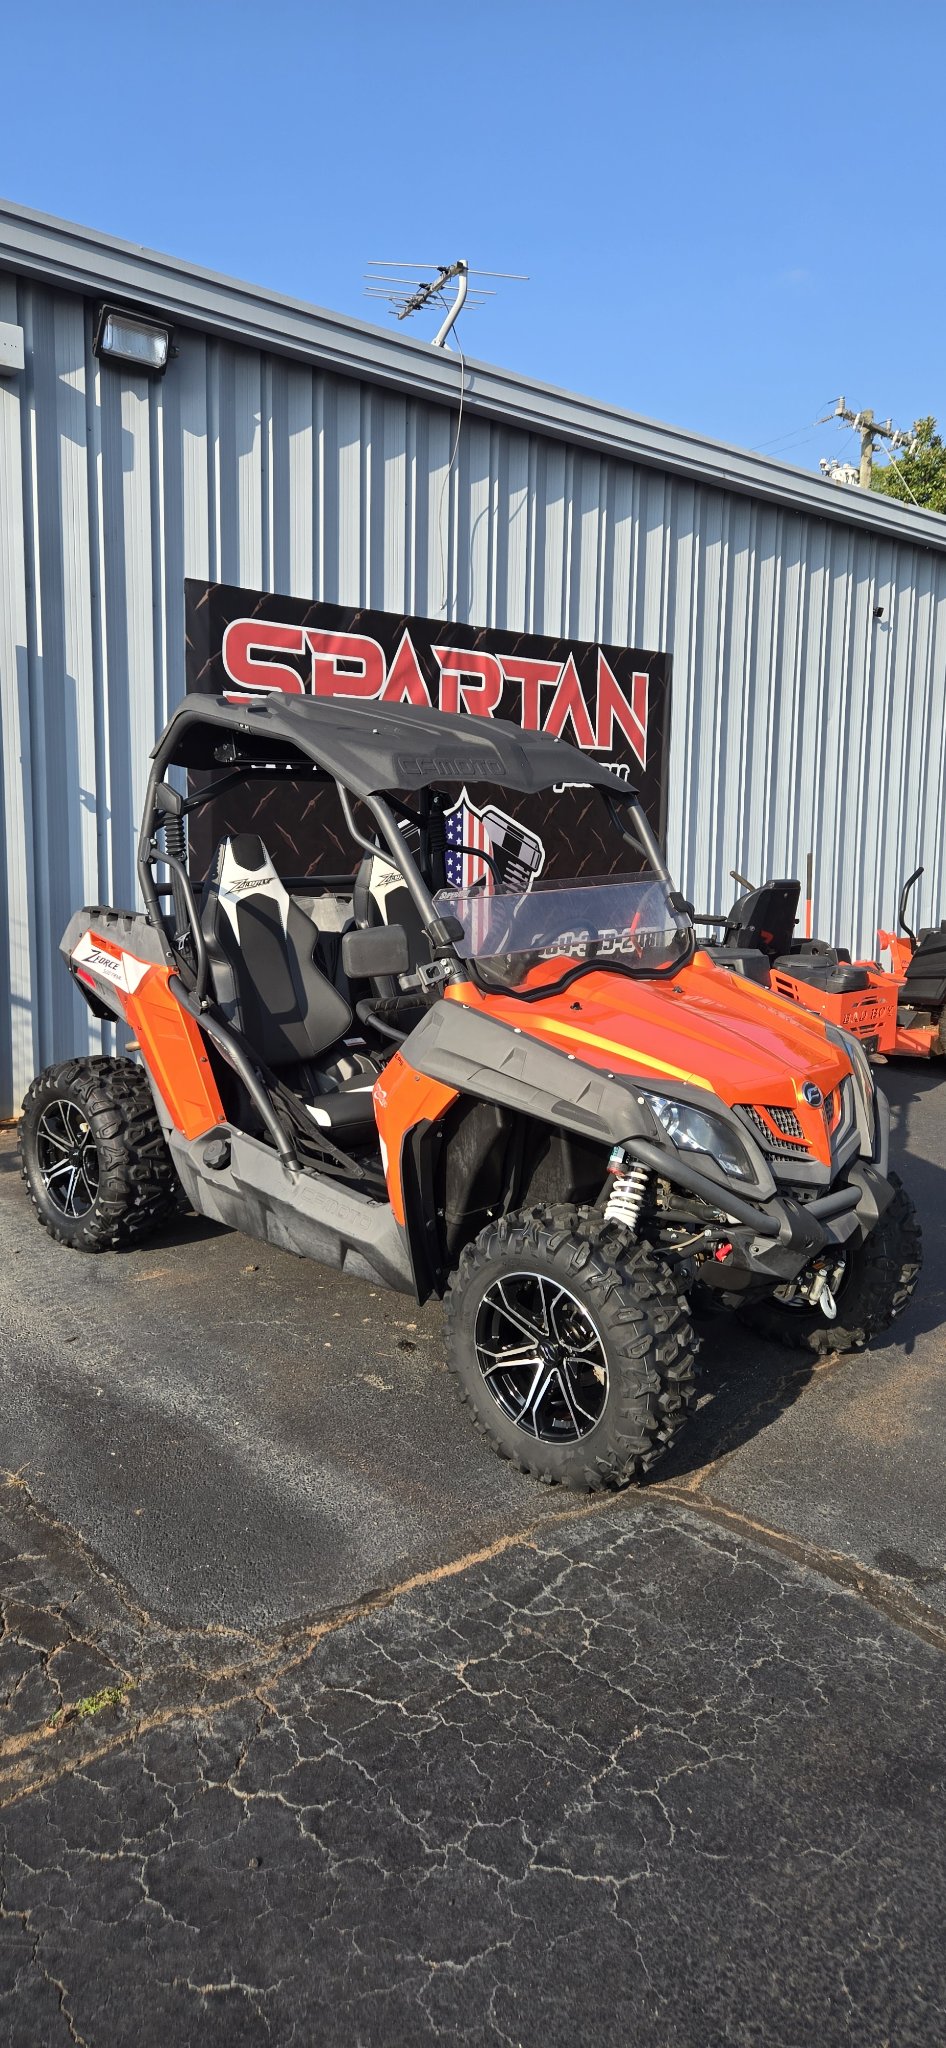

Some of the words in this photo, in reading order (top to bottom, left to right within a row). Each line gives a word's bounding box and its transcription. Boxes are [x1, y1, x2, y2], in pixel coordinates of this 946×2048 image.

[221, 616, 650, 772] SPARTAN
[397, 757, 506, 776] CFMOTO
[843, 1010, 868, 1024] BAD
[870, 1005, 895, 1020] BOY
